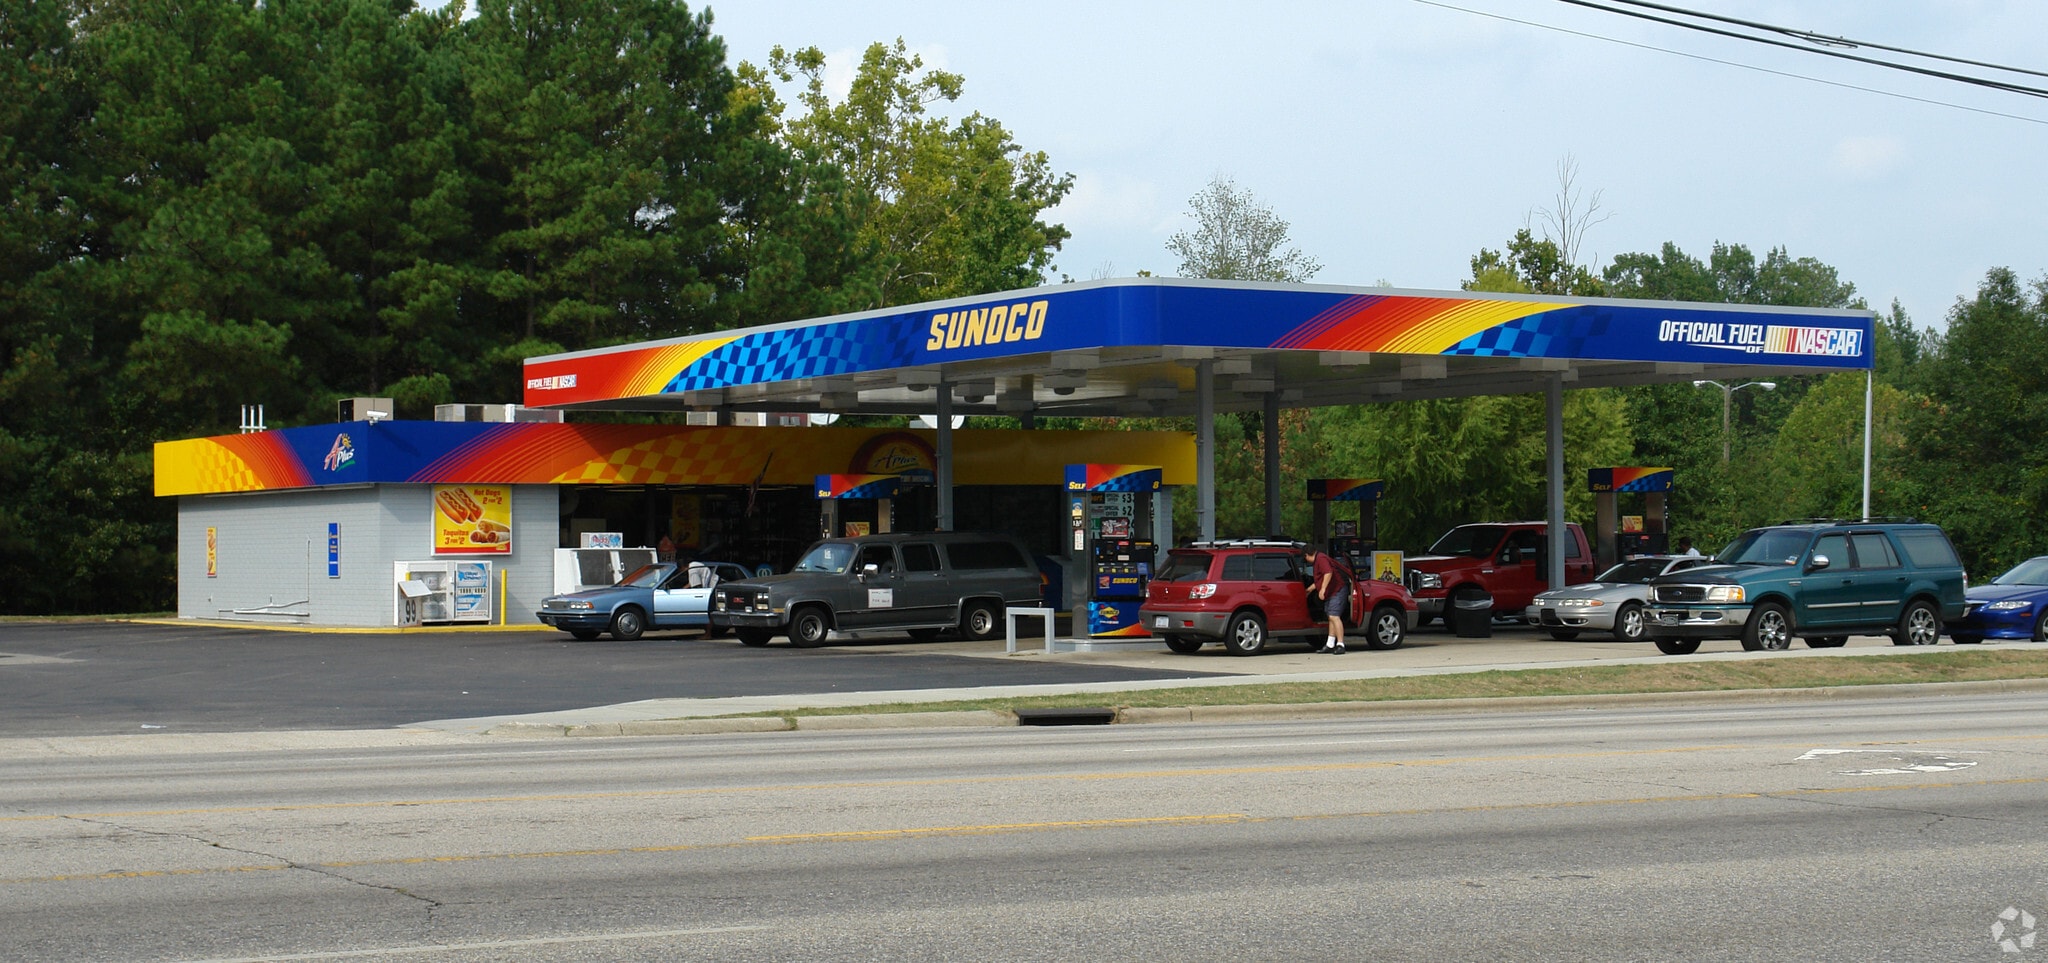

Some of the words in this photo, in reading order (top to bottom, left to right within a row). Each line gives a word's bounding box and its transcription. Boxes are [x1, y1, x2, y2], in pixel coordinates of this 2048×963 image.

[926, 300, 1048, 351] SUNOCO
[1659, 320, 1725, 343] OFFICIAL
[1727, 323, 1766, 344] FUEL
[1797, 328, 1860, 356] NASCAR
[1745, 345, 1764, 354] OF
[1152, 481, 1160, 490] 8
[1664, 481, 1672, 489] 7
[485, 489, 502, 497] Dogs
[443, 529, 468, 537] Taquitos
[445, 537, 451, 545] 3
